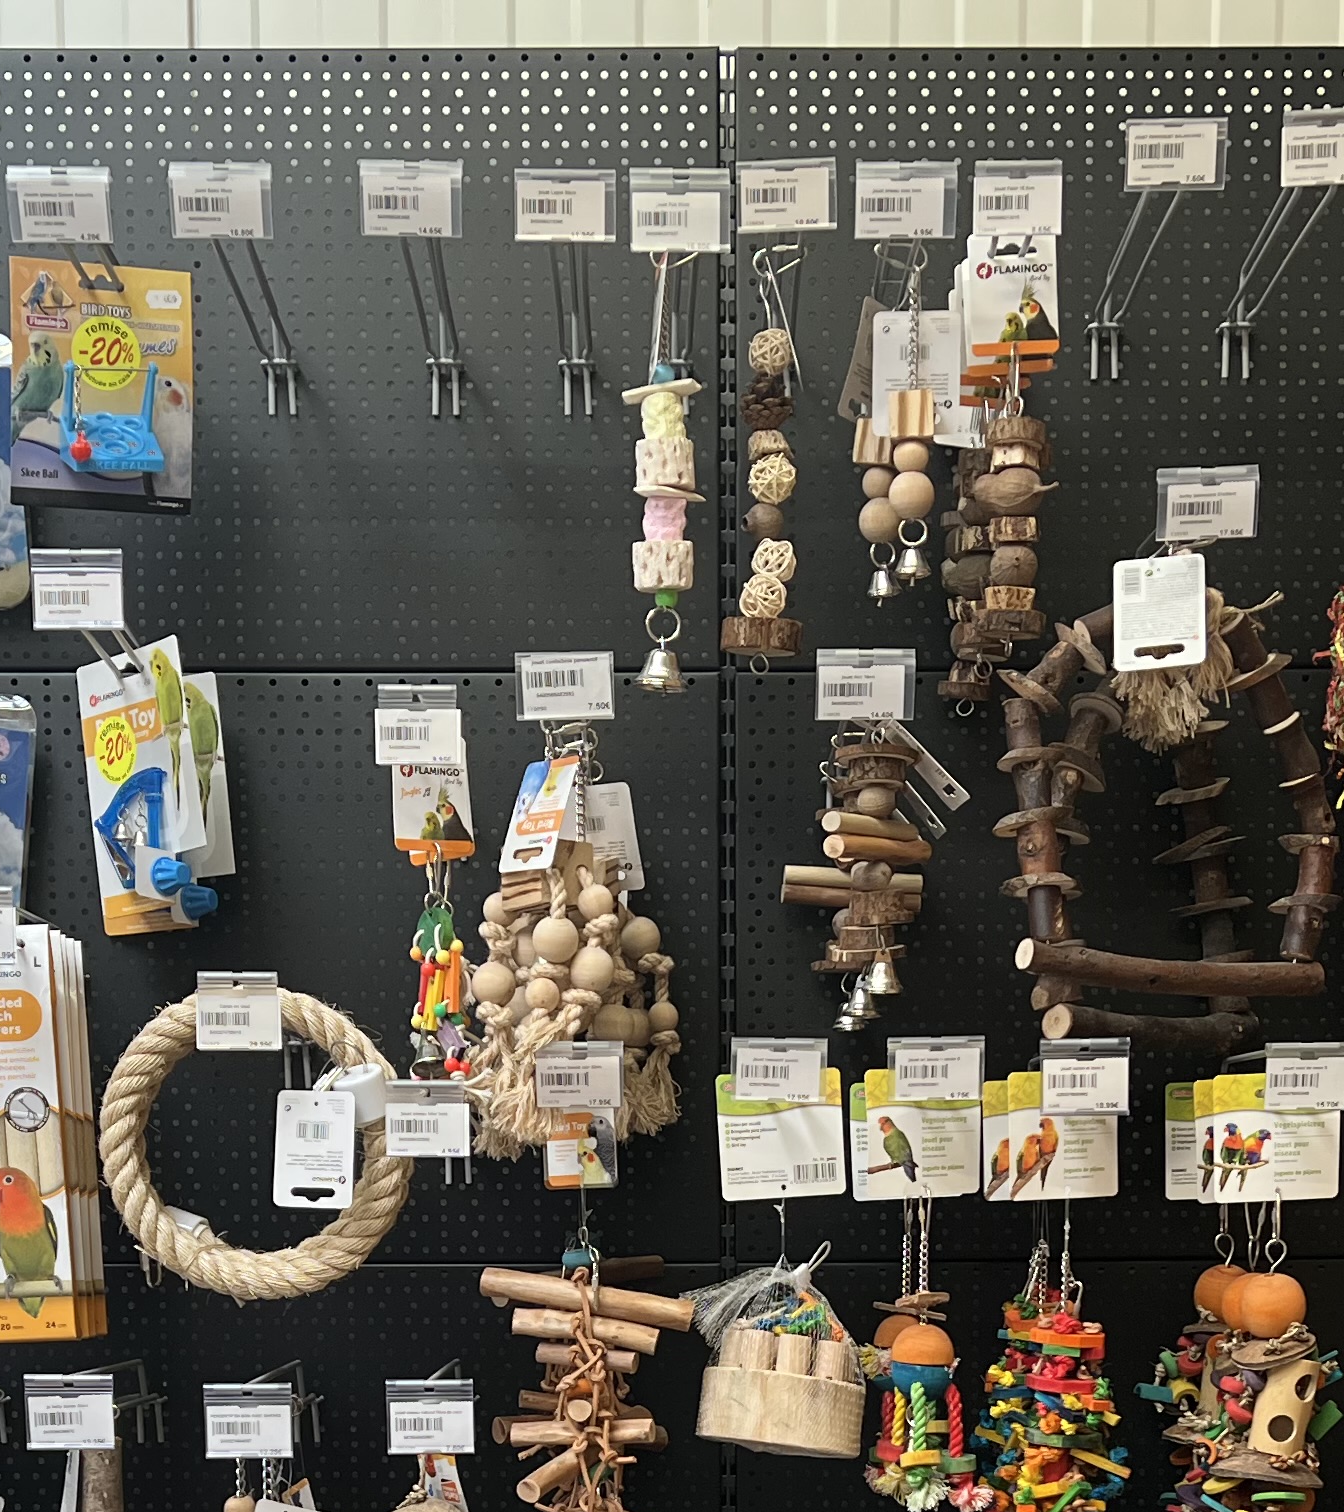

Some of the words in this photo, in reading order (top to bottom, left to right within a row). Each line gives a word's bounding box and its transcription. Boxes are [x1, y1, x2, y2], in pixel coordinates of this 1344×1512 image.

[993, 263, 1048, 275] FLAMINGO
[81, 304, 104, 315] BIRD
[106, 305, 132, 318] TOYS
[29, 316, 67, 329] Flamingo
[85, 318, 128, 340] remise
[79, 336, 134, 366] -20%
[20, 468, 38, 477] Skee
[42, 469, 58, 480] Ball
[129, 707, 156, 730] Toy
[99, 720, 125, 741] remise
[414, 766, 460, 777] FLAMINGO
[521, 820, 535, 831] Toy
[537, 819, 555, 830] Bird
[34, 956, 41, 967] L
[921, 1115, 967, 1126] Vogelspielzeug
[1274, 1120, 1325, 1130] Vogelspielzeug
[0, 1323, 11, 1331] 20
